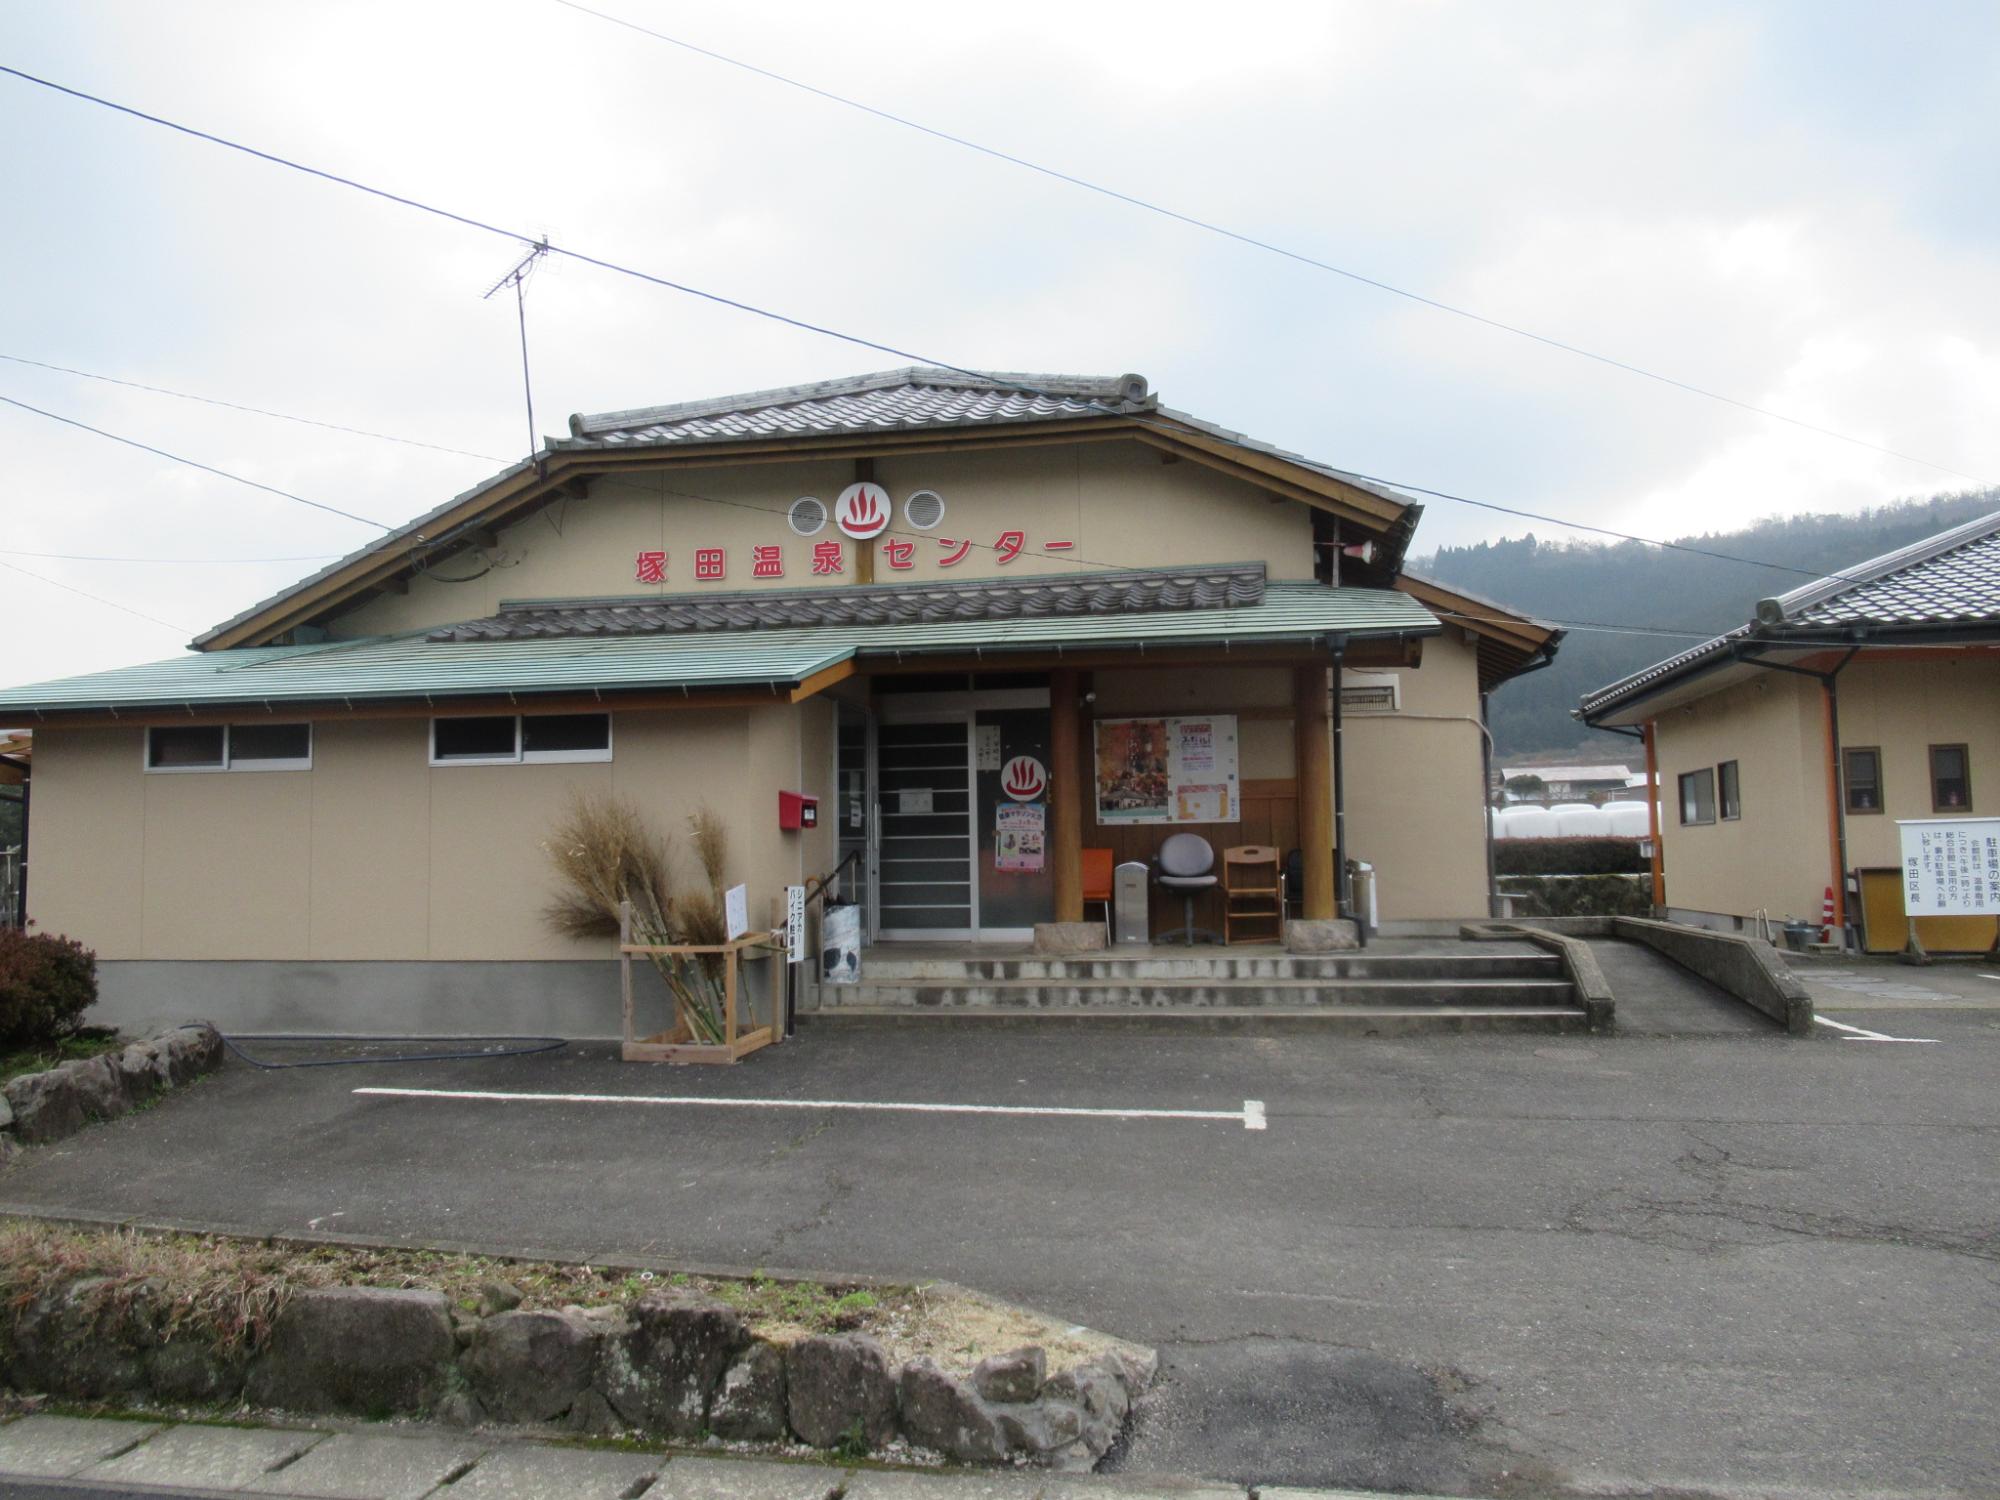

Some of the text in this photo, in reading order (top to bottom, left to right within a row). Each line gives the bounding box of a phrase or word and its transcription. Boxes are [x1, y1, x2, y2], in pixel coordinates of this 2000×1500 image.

[636, 530, 1075, 583] 塚田温泉センター
[1908, 857, 1920, 902] 塚田区長
[1986, 837, 2000, 902] 駐車場の案内
